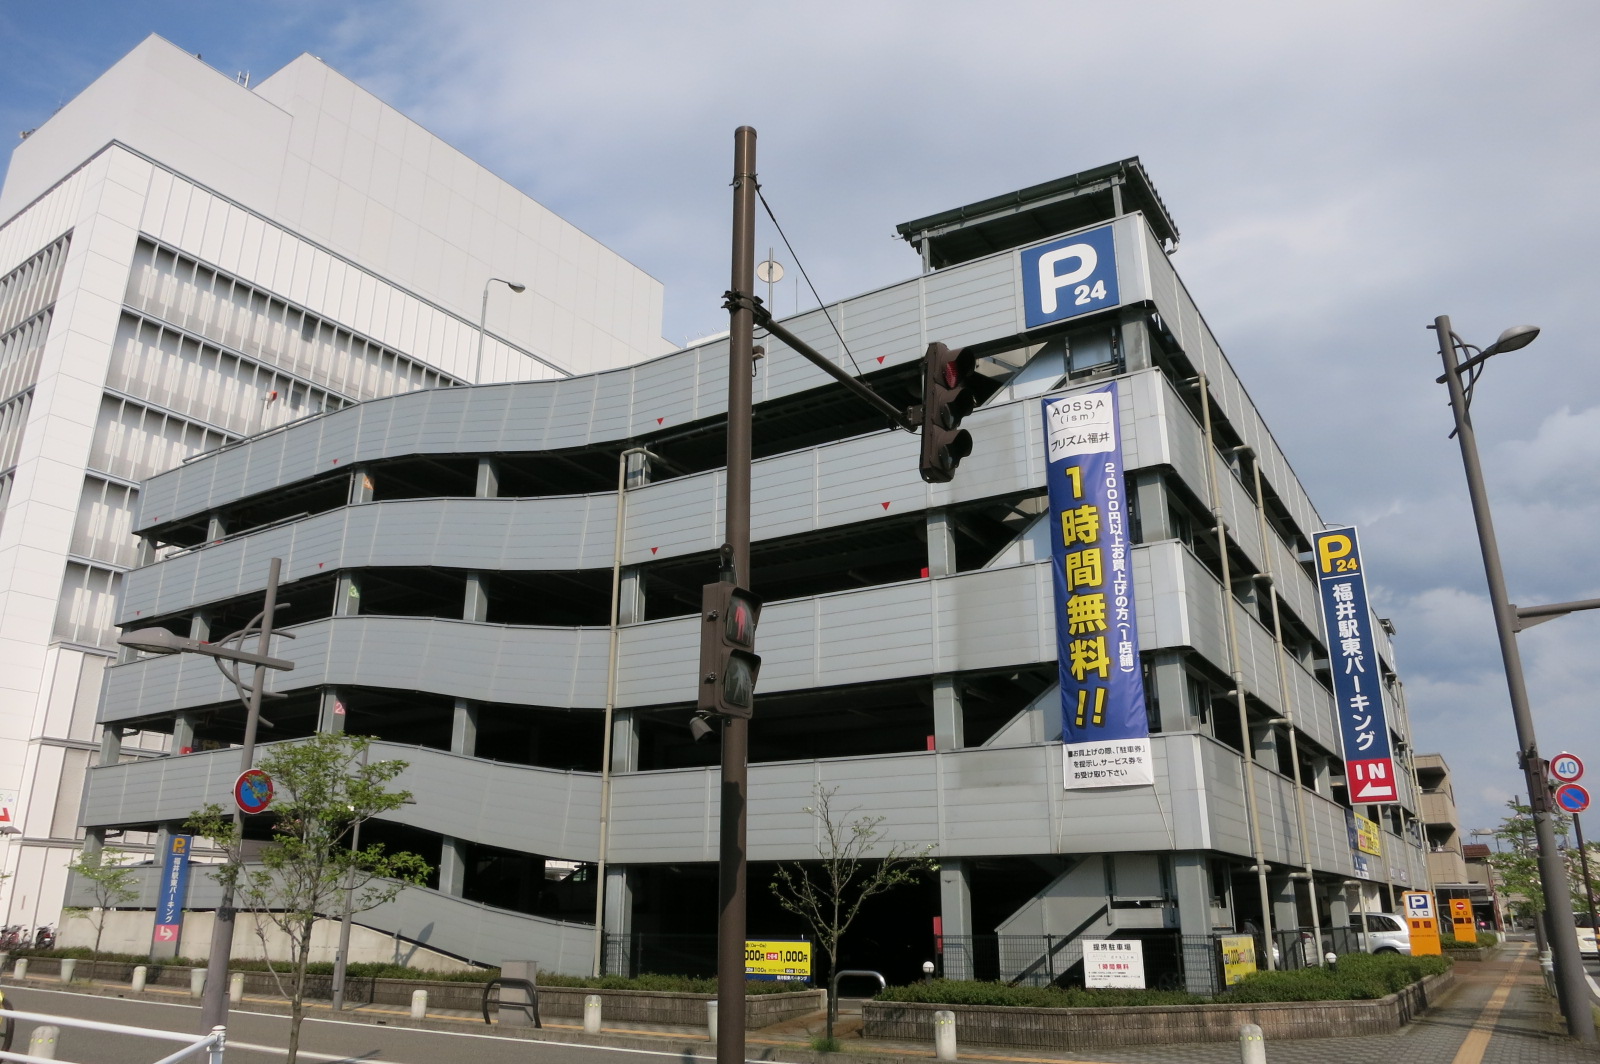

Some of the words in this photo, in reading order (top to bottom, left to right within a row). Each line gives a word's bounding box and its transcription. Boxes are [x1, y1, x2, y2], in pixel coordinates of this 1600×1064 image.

[1038, 243, 1098, 315] P
[1074, 280, 1107, 306] 24
[1052, 400, 1104, 417] AOSSA
[1060, 412, 1095, 425] (ism)
[1318, 534, 1352, 573] P
[1336, 557, 1358, 572] 24
[1332, 582, 1375, 751] 福井駅東パーキング
[1074, 769, 1128, 779] お受け取り下さい
[1356, 763, 1385, 780] IN
[1559, 761, 1577, 774] 40
[172, 837, 186, 853] P
[1410, 896, 1425, 908] P
[779, 951, 808, 963] 1,000円
